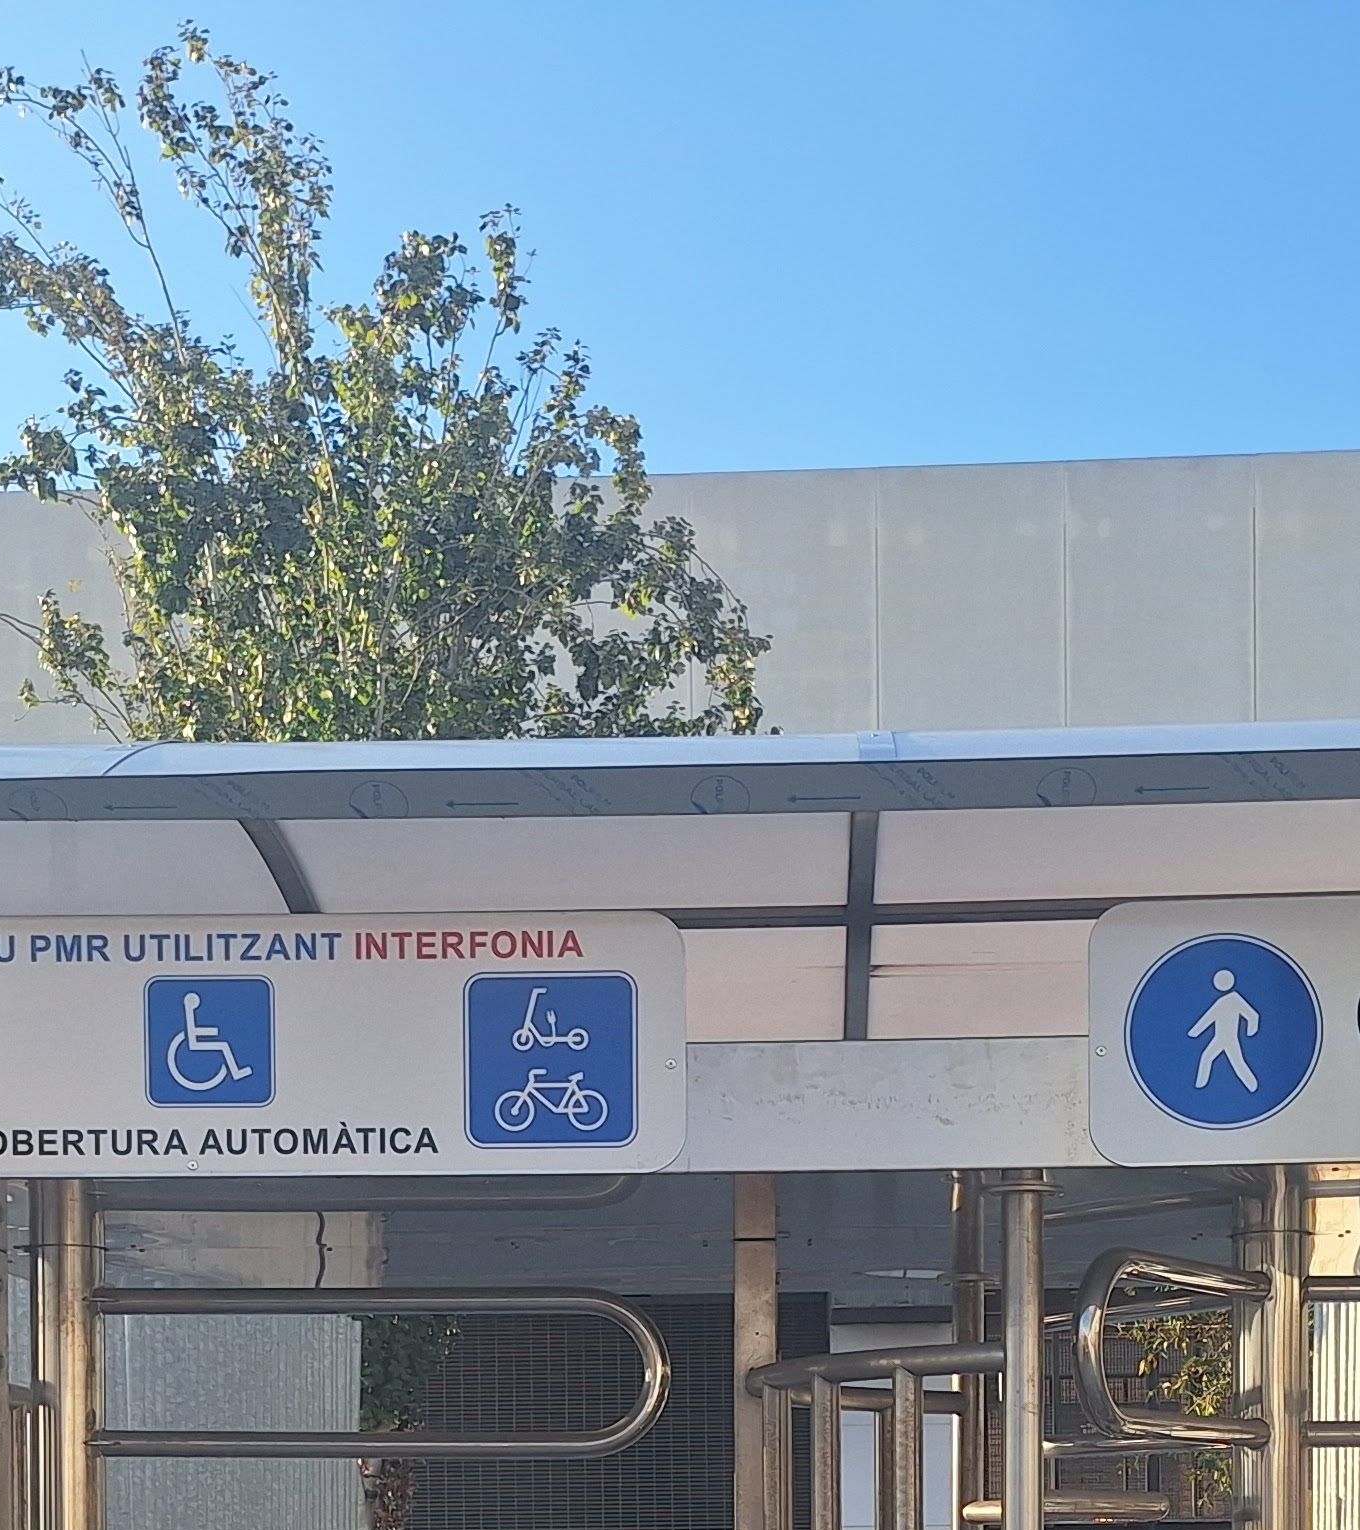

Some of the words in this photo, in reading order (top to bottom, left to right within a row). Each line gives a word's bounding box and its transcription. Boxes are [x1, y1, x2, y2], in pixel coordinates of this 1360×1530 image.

[30, 934, 111, 963] PMR
[123, 932, 342, 962] UTILITZANT
[354, 929, 585, 960] INTERFONIA
[199, 1121, 439, 1156] AUTOMÀTICA
